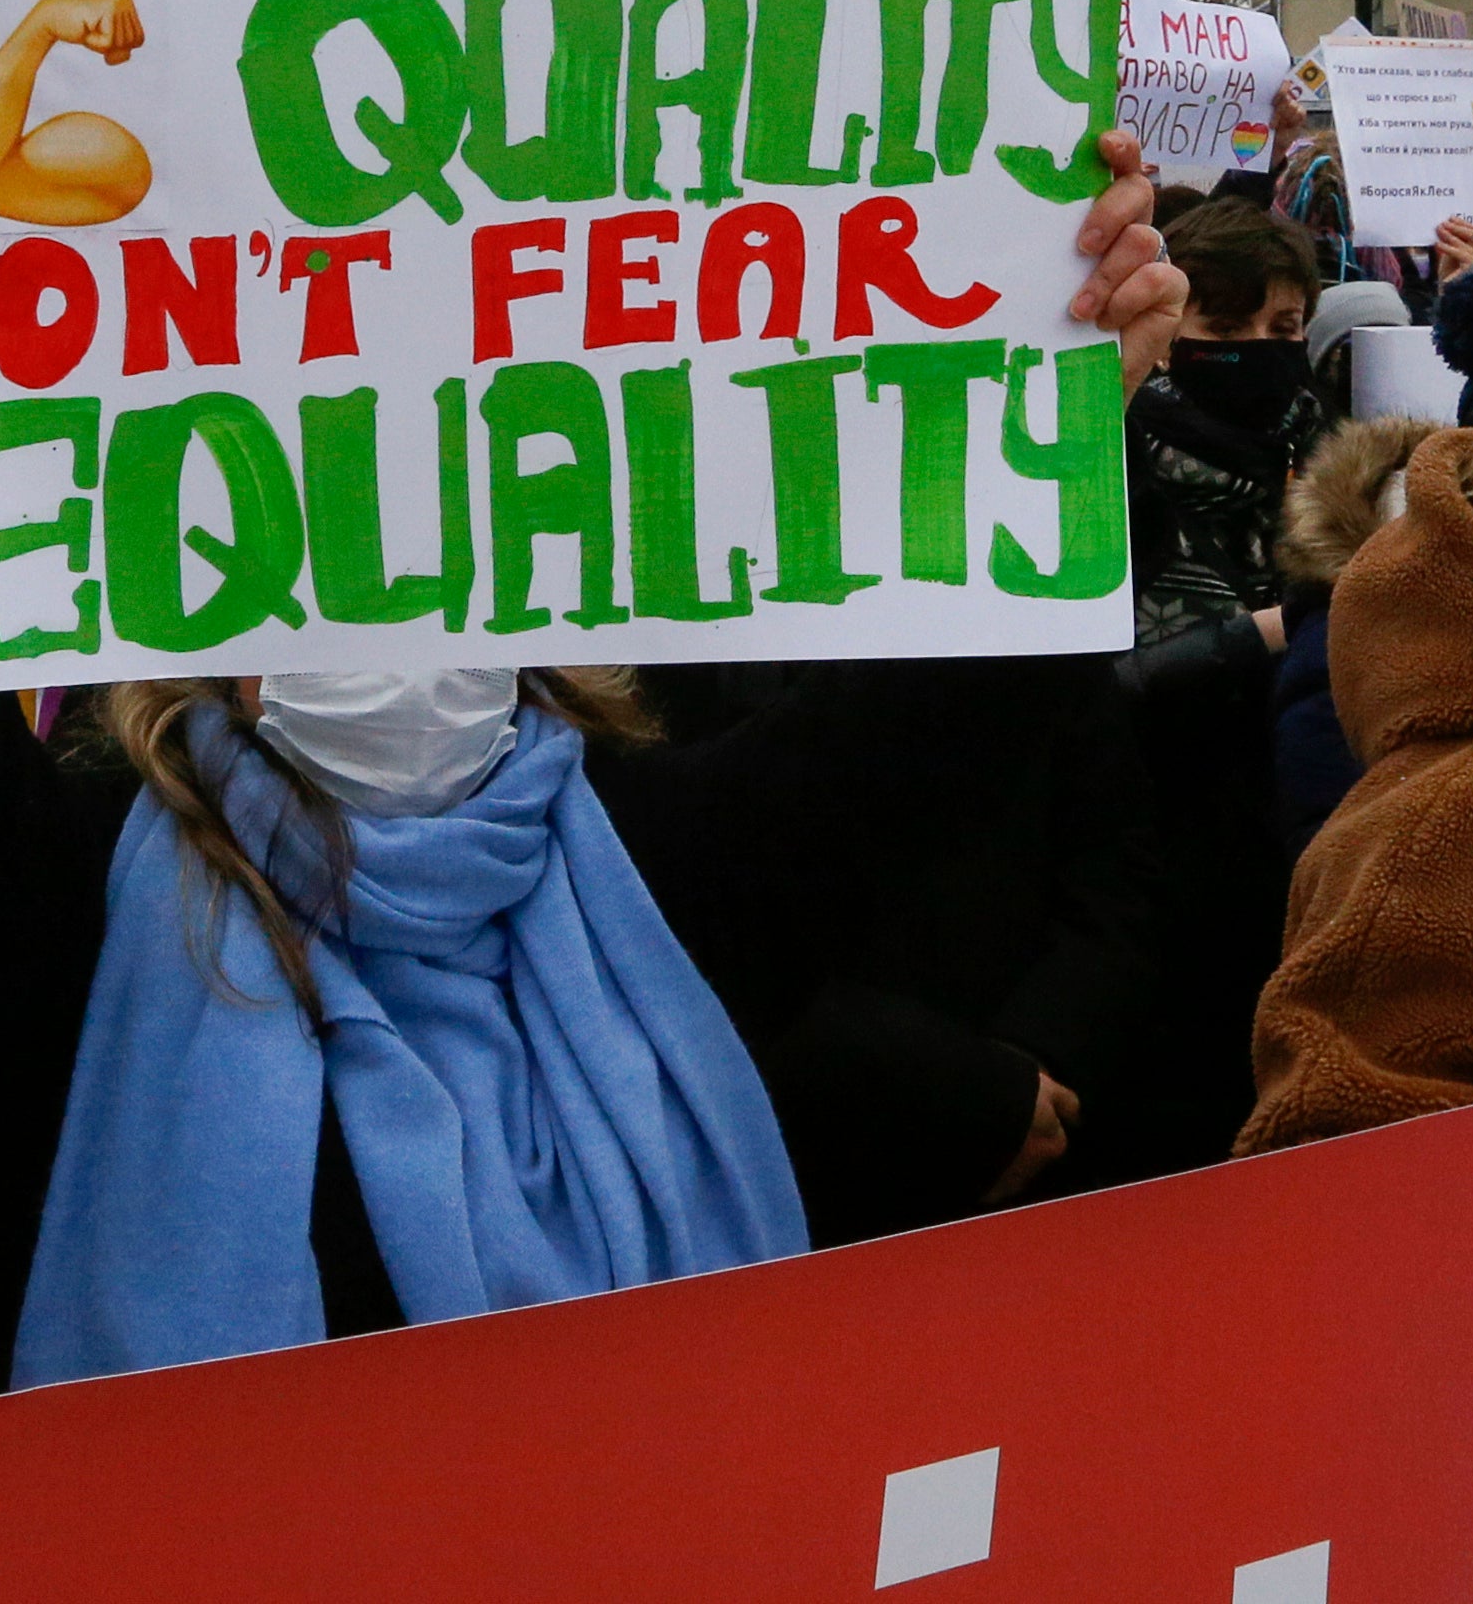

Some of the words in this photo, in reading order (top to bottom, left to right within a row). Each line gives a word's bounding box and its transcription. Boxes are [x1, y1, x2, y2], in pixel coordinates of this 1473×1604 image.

[1161, 10, 1248, 62] МАЮ
[1121, 59, 1207, 94] ПРАВО
[1223, 69, 1255, 104] НА
[1116, 94, 1242, 157] ВИБІР
[1358, 118, 1379, 128] Хіба
[1383, 120, 1427, 130] тремтить
[1429, 120, 1447, 128] моя
[1360, 184, 1455, 199] #БорюсяЯкЛеся
[471, 196, 1000, 363] FEAR
